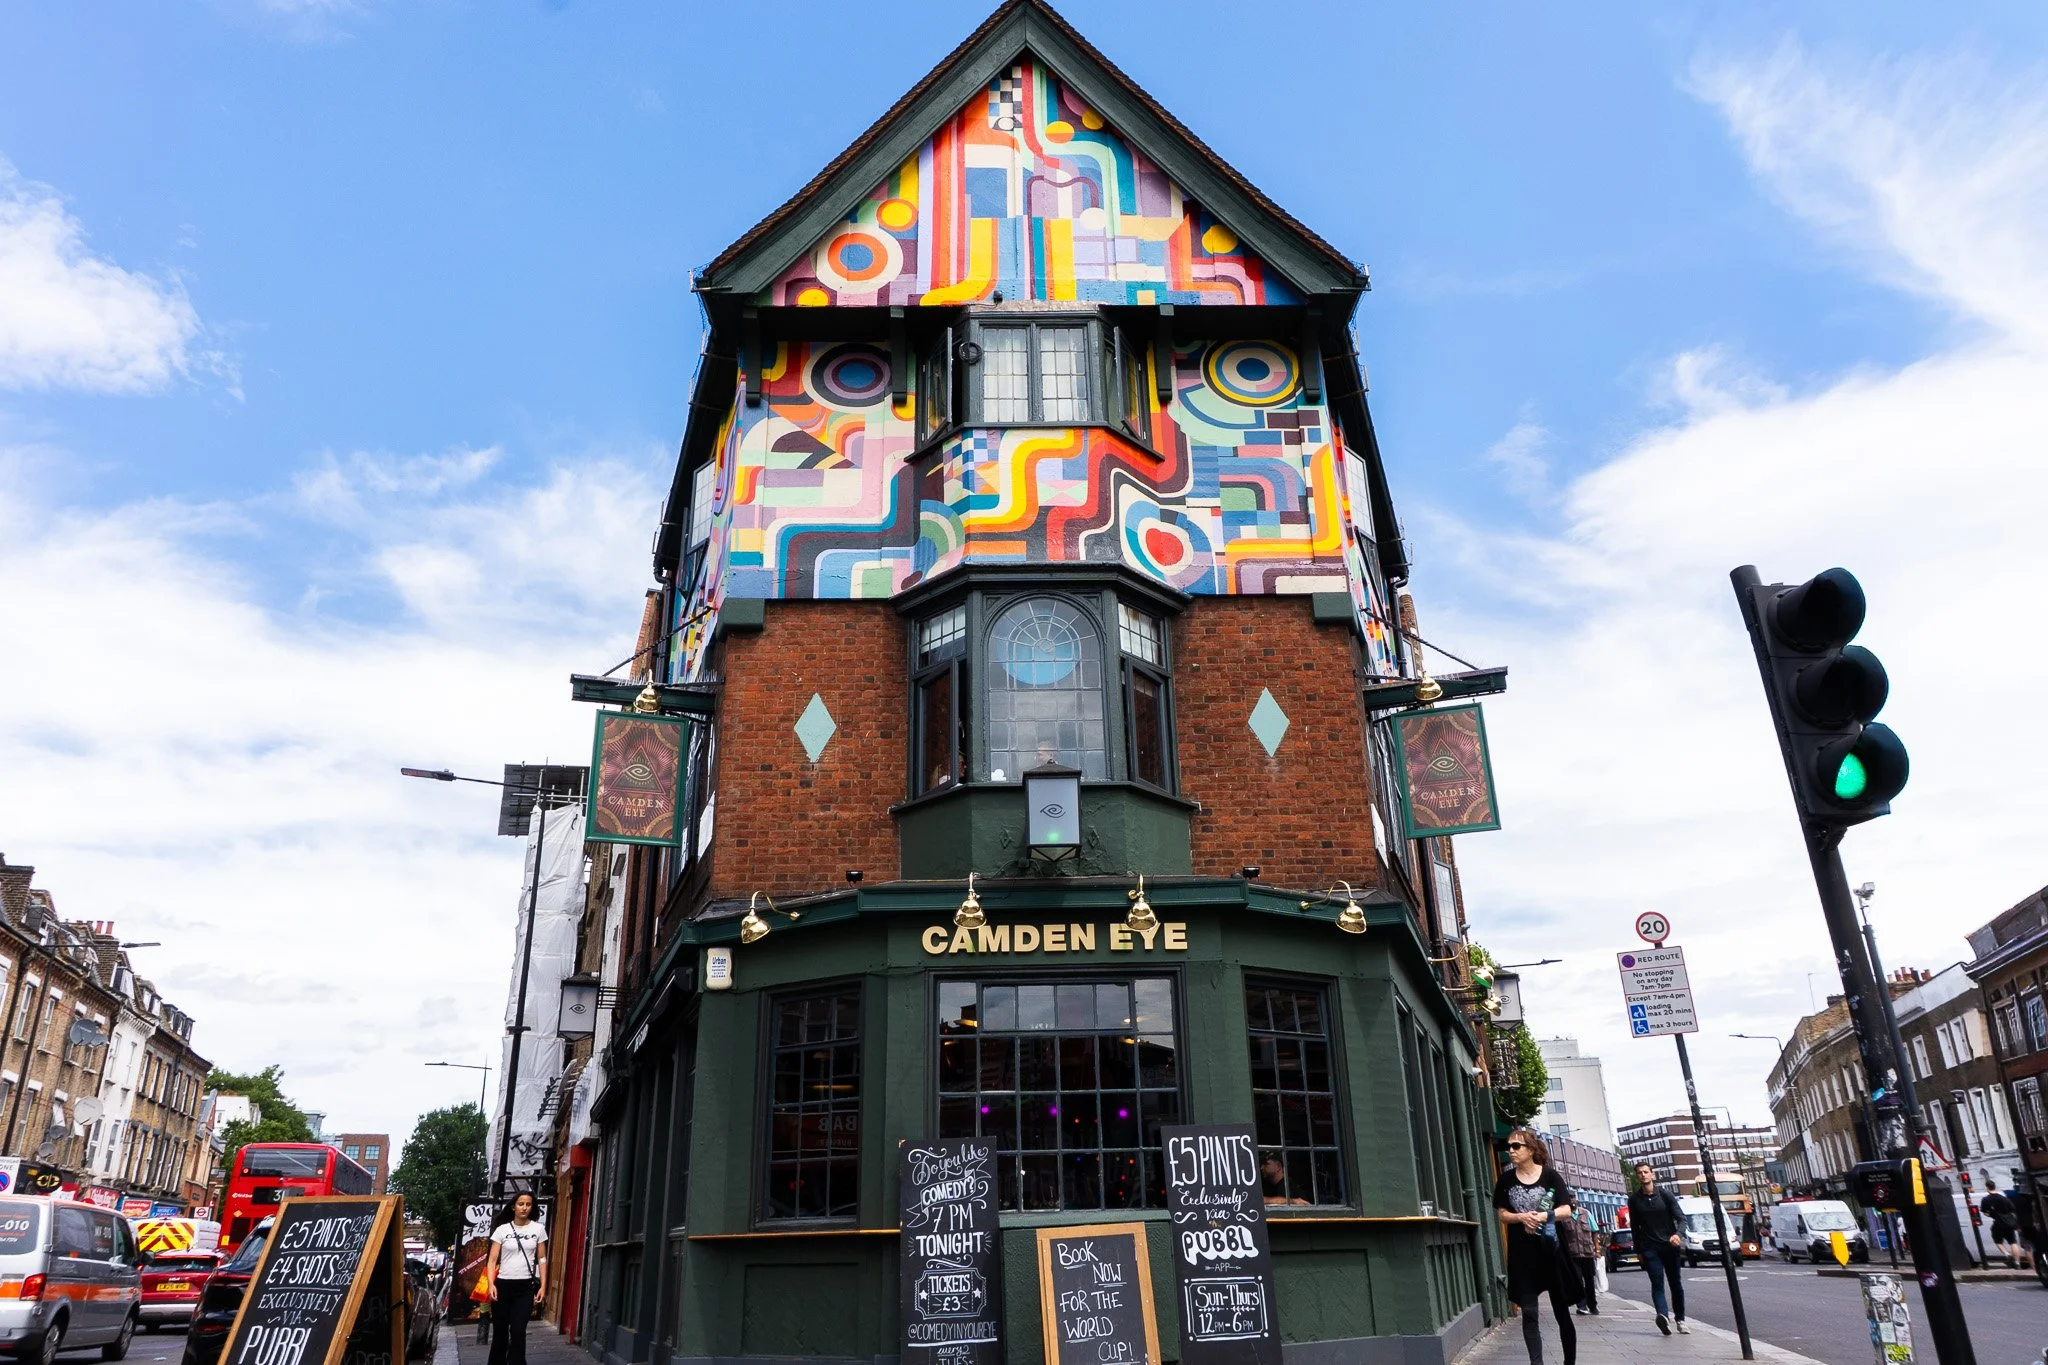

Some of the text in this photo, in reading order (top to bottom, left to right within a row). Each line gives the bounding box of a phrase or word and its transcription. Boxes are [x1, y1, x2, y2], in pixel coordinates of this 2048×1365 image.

[608, 796, 664, 808] CAMDEN
[1421, 786, 1476, 800] CAMDEN
[625, 808, 646, 817] EYE
[1439, 799, 1461, 808] EYE
[1641, 920, 1665, 935] 20
[921, 922, 1188, 955] CAMDEN EYE
[1654, 953, 1680, 962] ROUTE
[1644, 969, 1674, 978] stopping
[1660, 976, 1673, 984] day
[1640, 983, 1672, 991] 7am-7pm
[1628, 995, 1651, 1003] Except
[1646, 1002, 1672, 1011] loading
[1673, 1019, 1693, 1028] hours
[910, 1144, 989, 1185] Do you like
[1169, 1135, 1256, 1188] £5 PINTS
[922, 1176, 975, 1206] COMEDY?
[1178, 1187, 1249, 1212] Exclusively
[932, 1203, 974, 1233] 7 PM
[280, 1218, 352, 1249] £5 PINTS
[916, 1232, 984, 1257] TONIGHT
[1057, 1241, 1099, 1266] BOOK
[1182, 1225, 1259, 1265] PUBBL
[266, 1254, 340, 1285] £4 SHOTS
[1092, 1263, 1122, 1284] NOW
[1214, 1263, 1231, 1272] APP
[928, 1274, 971, 1294] TICKETS
[258, 1292, 343, 1315] EXCLUSIVELY
[943, 1296, 961, 1311] £3
[1060, 1290, 1123, 1312] FOR THE
[1195, 1284, 1260, 1308] Sun-Thurs
[283, 1310, 302, 1325] VIA
[1063, 1316, 1114, 1339] WORLD
[908, 1321, 997, 1341] @COMEDYINYOUREYE
[1098, 1341, 1134, 1362] CUP!
